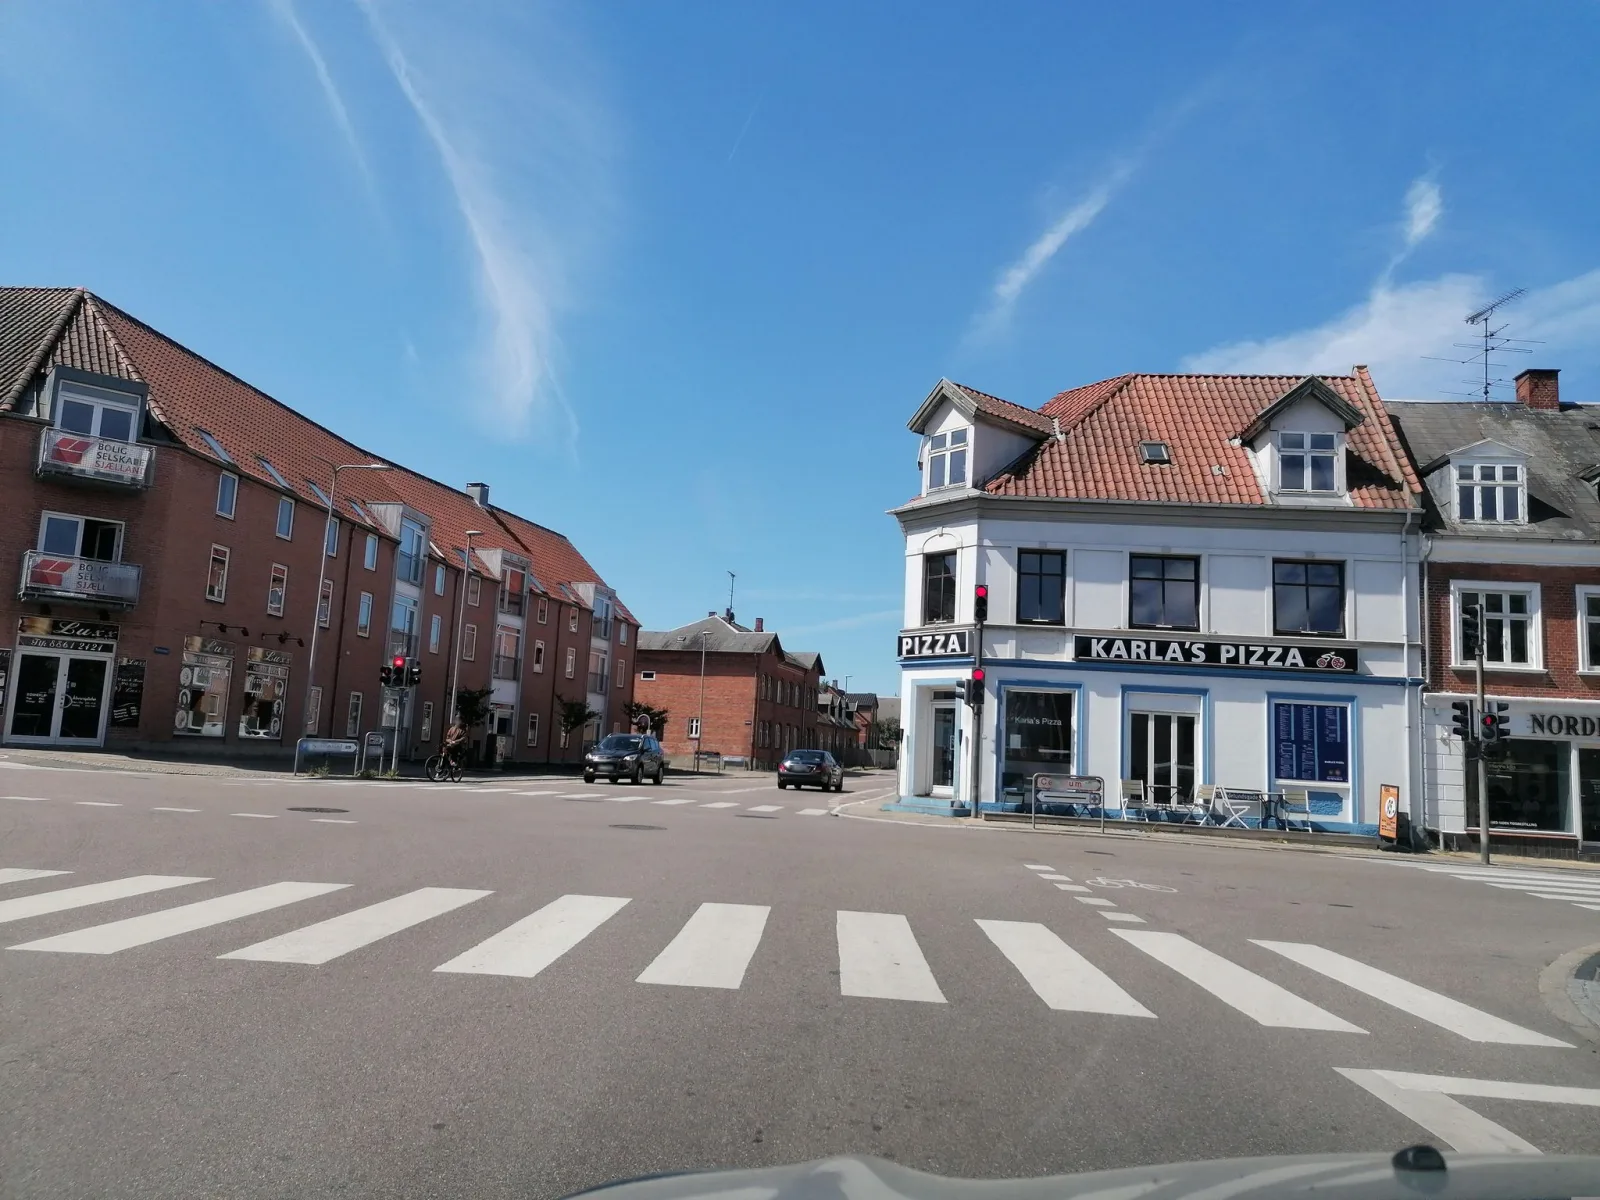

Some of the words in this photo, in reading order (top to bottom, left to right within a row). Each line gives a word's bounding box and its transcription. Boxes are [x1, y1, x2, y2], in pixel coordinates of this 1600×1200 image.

[98, 442, 127, 455] BOLIG
[53, 621, 117, 638] Luxx
[902, 634, 961, 655] PIZZA
[1091, 639, 1206, 663] KARLA'S
[1220, 645, 1305, 667] PIZZA
[1014, 716, 1040, 725] Karla's
[1041, 717, 1062, 726] Pizza
[1041, 777, 1082, 788] Ceum
